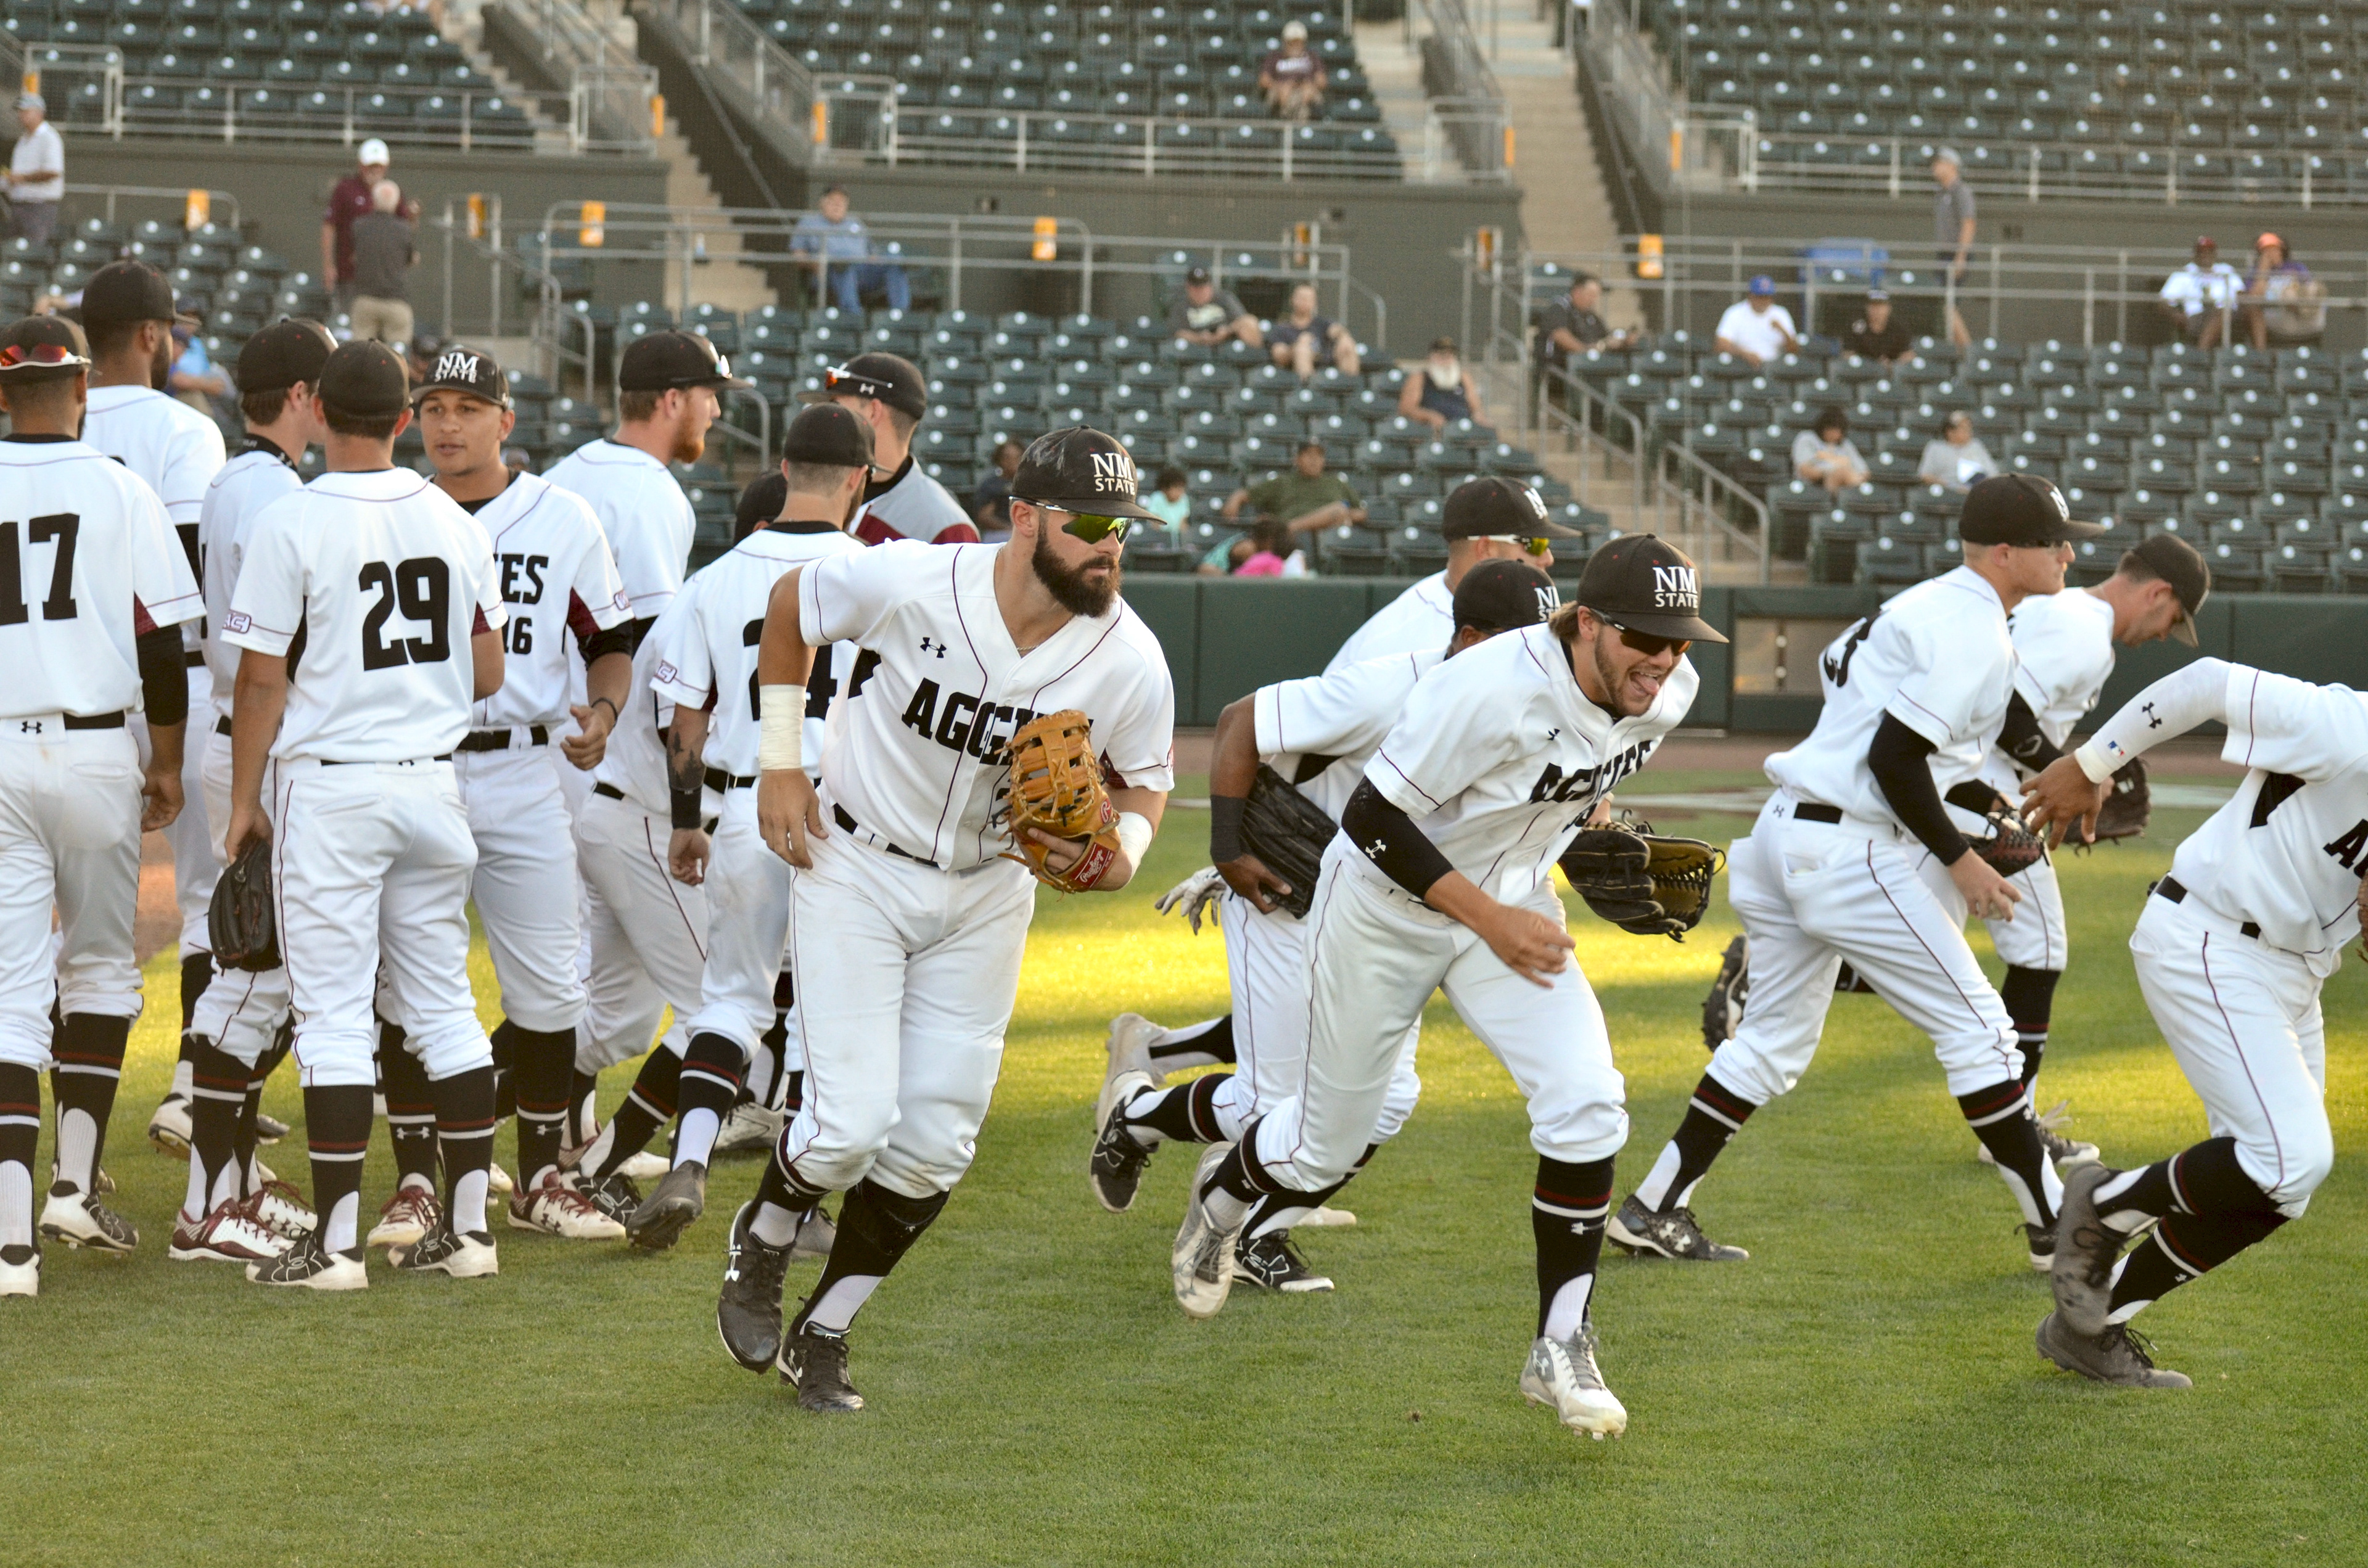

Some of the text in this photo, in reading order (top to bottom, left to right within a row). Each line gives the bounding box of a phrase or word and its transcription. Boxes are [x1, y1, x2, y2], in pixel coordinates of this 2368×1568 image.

[434, 367, 477, 384] STATE
[438, 352, 479, 371] NM
[1090, 452, 1133, 481] NM
[1095, 478, 1135, 495] STATE
[0, 513, 80, 626] 17
[1652, 566, 1698, 594] NM
[358, 557, 450, 671] 29
[1655, 593, 1698, 609] STATE
[2322, 818, 2368, 880] A
